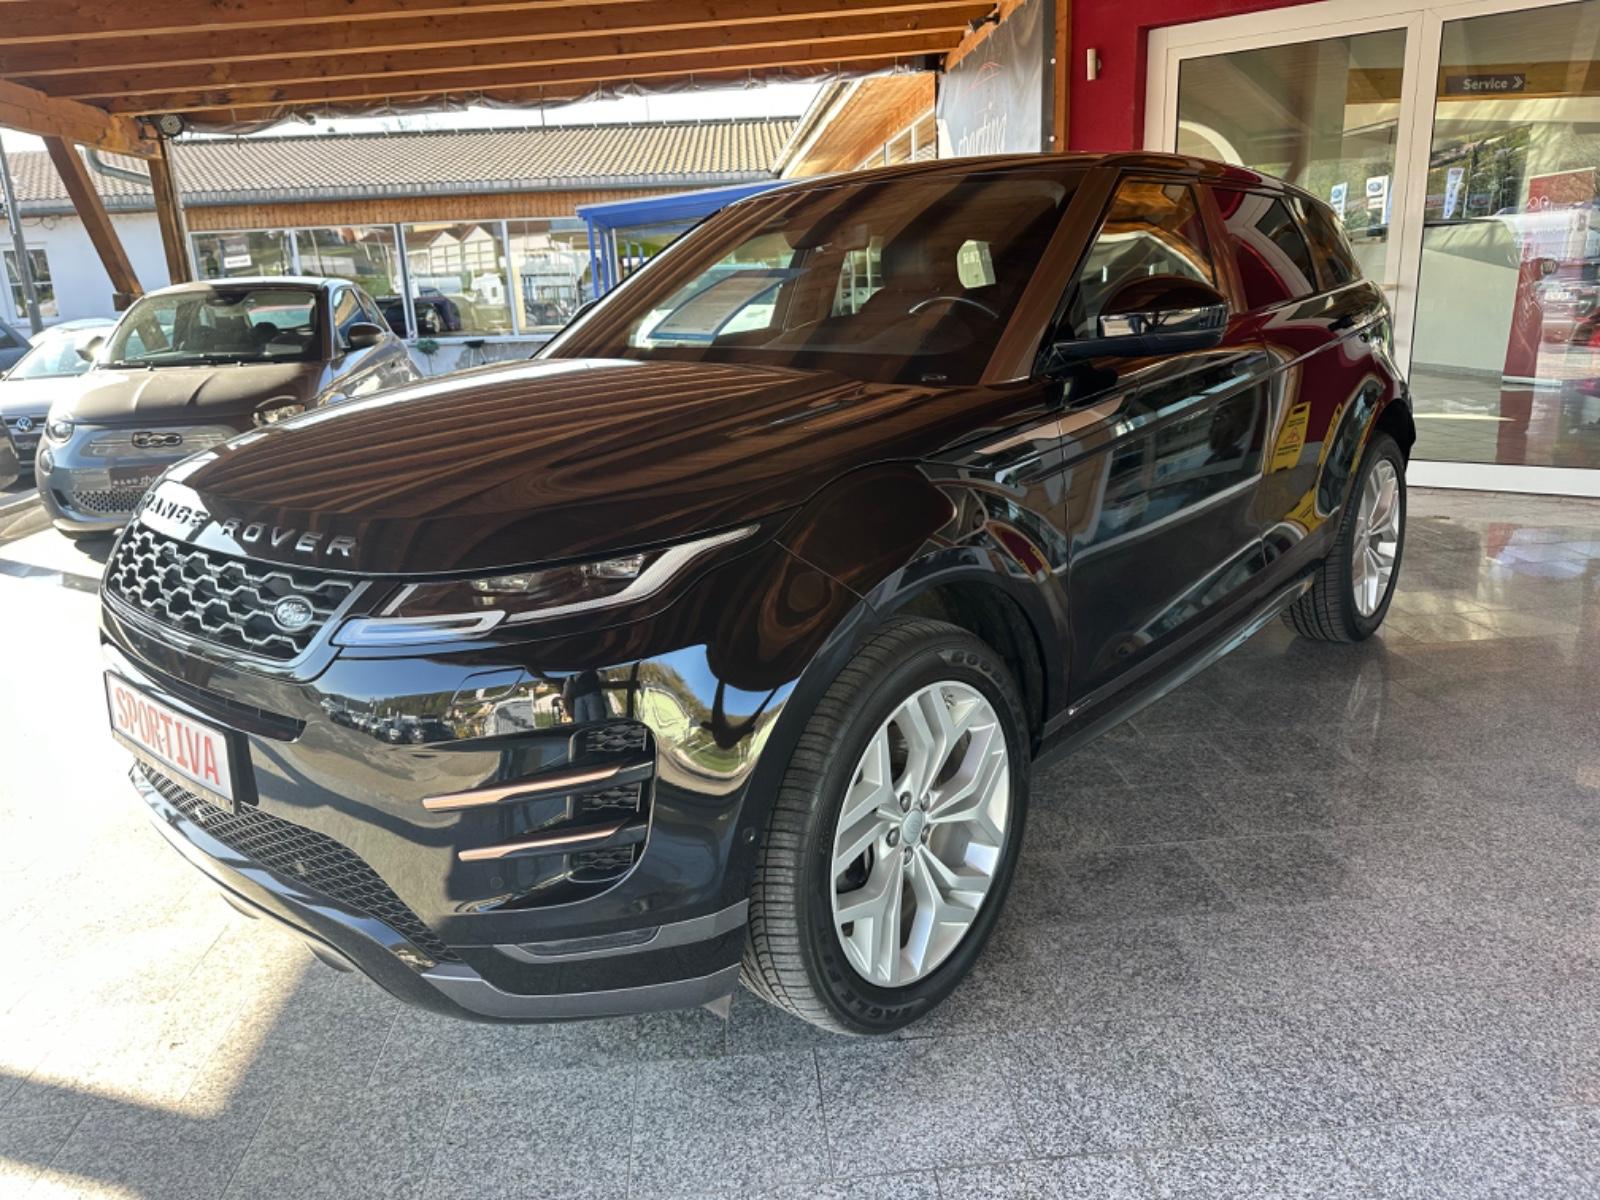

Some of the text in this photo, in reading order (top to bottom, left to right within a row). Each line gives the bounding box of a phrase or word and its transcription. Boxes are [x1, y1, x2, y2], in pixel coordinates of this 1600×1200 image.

[1463, 77, 1508, 90] Service
[221, 518, 356, 556] ROVER
[115, 687, 220, 785] SPORTIVA
